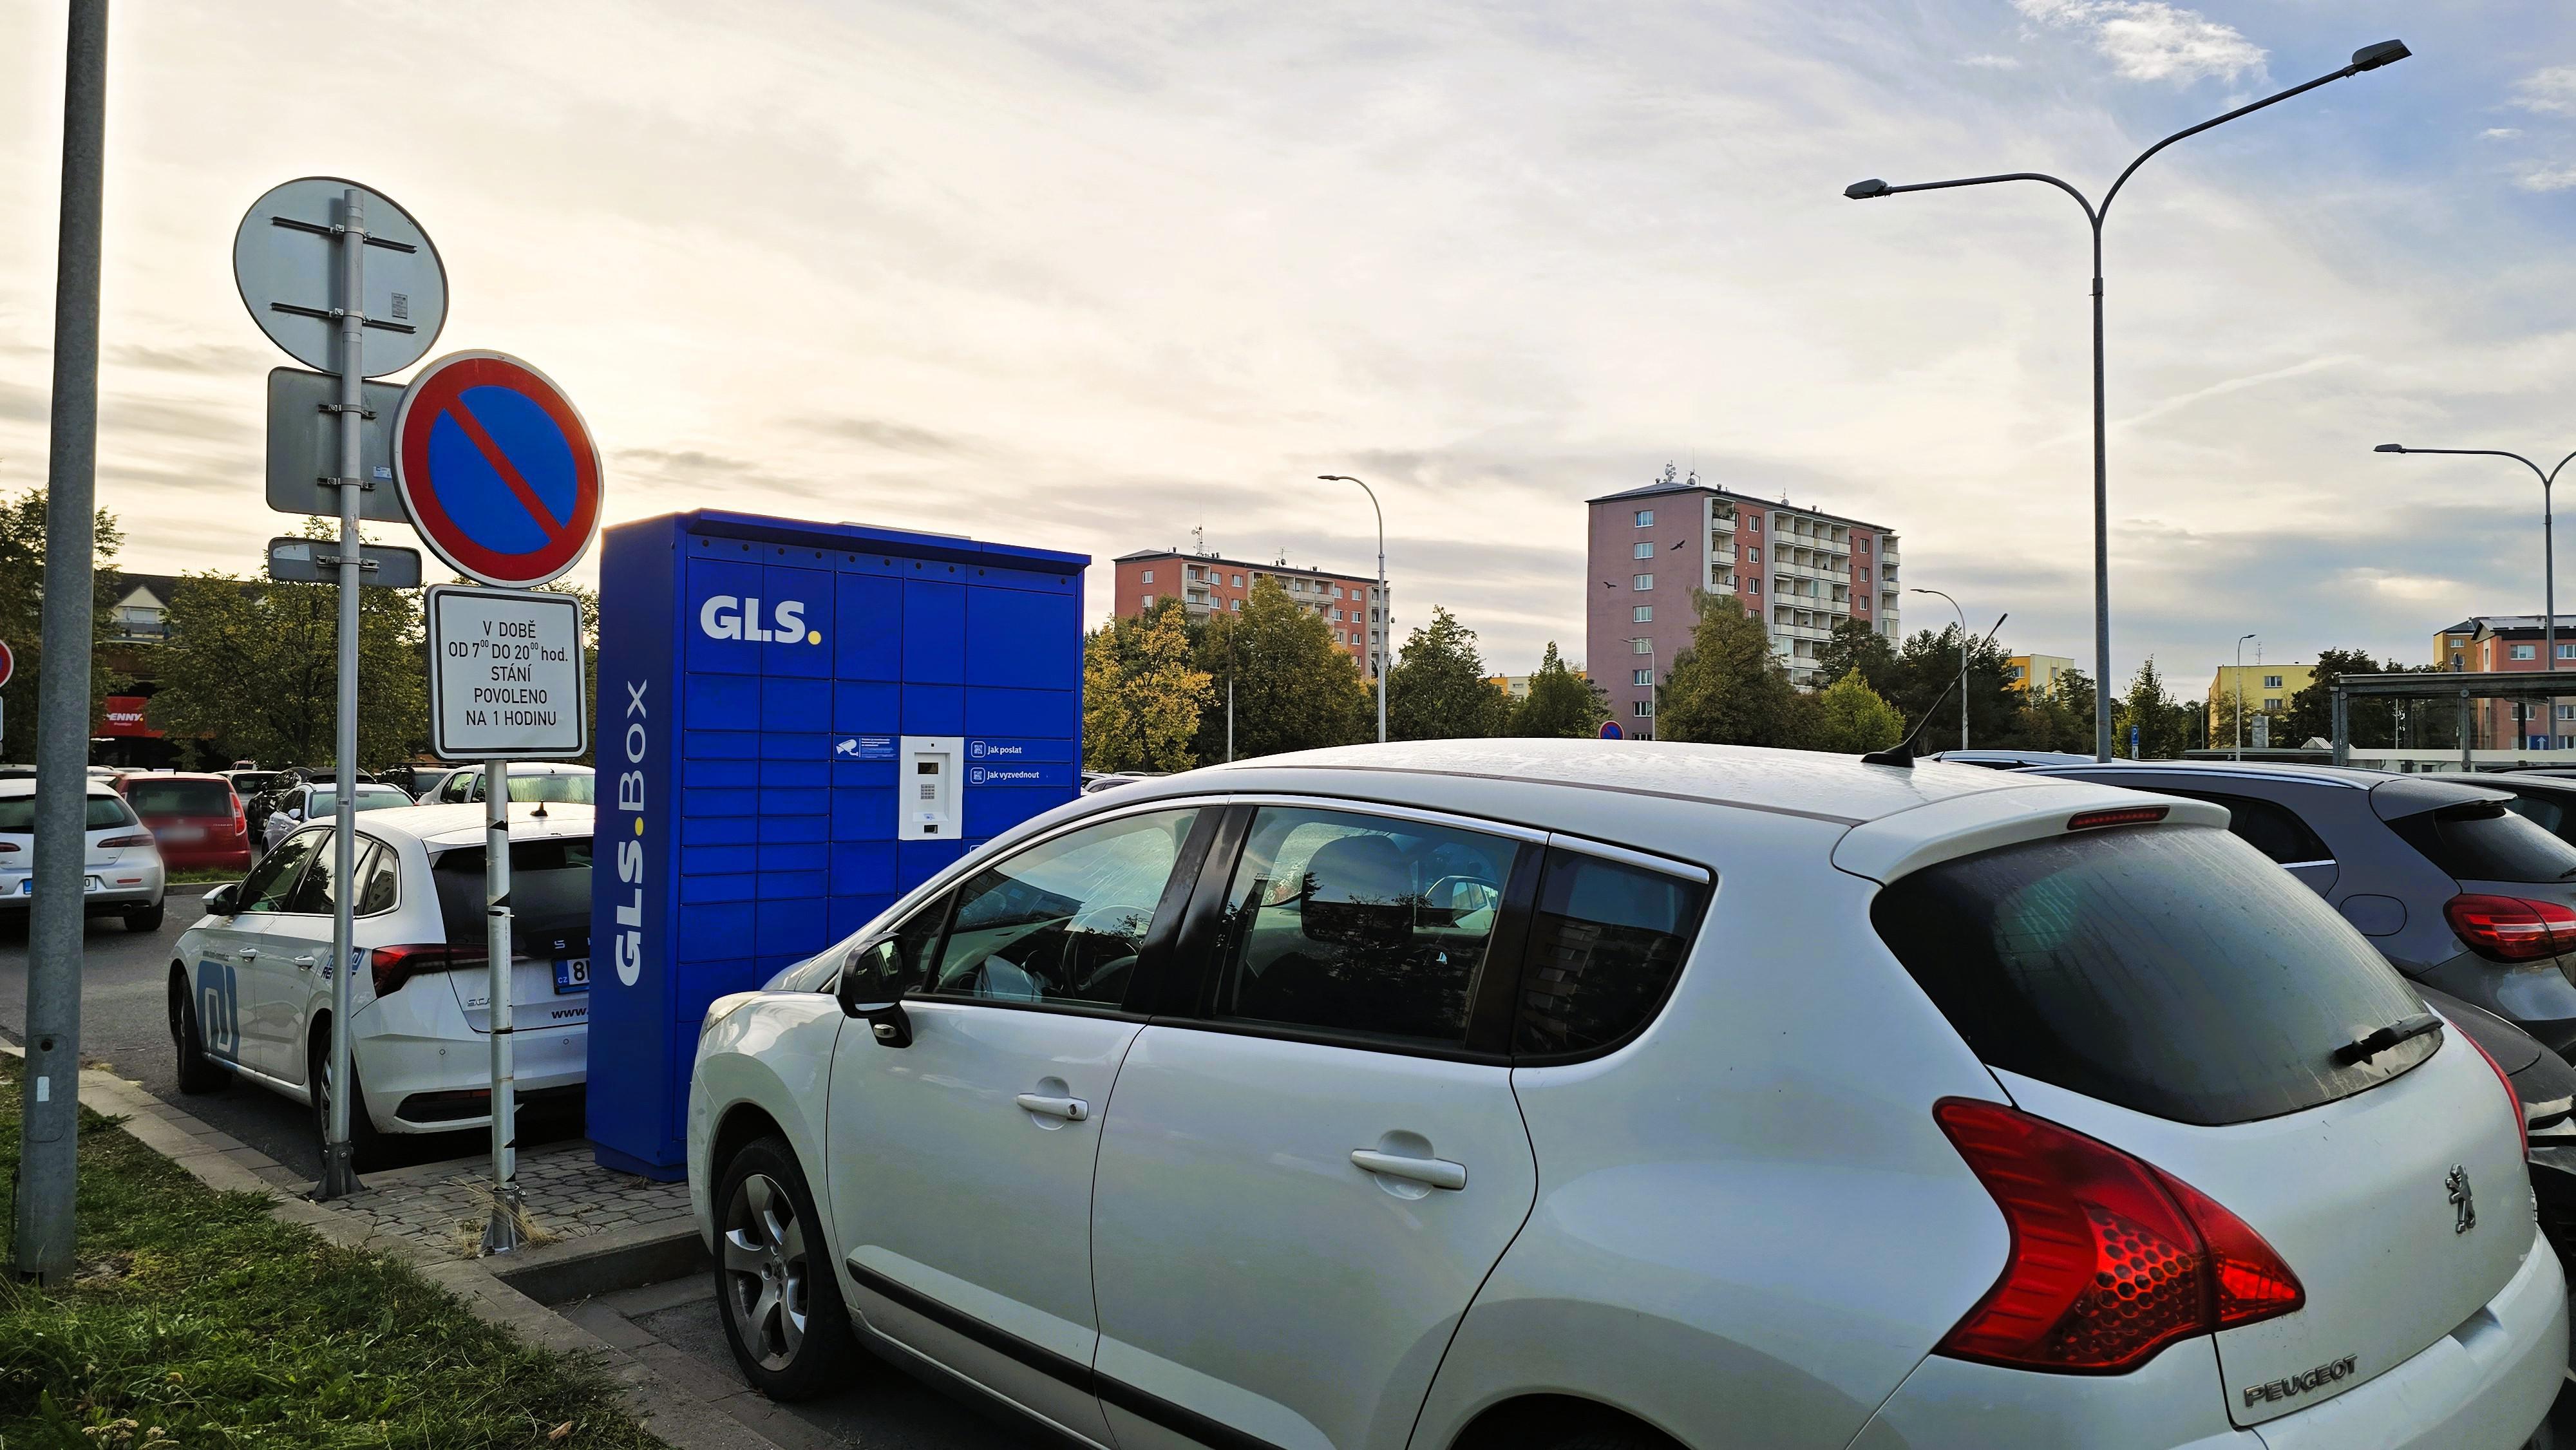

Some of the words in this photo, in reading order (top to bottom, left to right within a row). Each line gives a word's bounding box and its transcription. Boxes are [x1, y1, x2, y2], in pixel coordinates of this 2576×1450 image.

[483, 620, 492, 636] V
[499, 619, 536, 639] DOBĚ
[448, 641, 468, 657] OD
[491, 643, 511, 659] DO
[541, 646, 569, 662] hod.
[491, 663, 532, 683] STÁNÍ
[474, 687, 547, 704] POVOLENO
[106, 713, 144, 722] ENNY.
[466, 710, 488, 726] NA
[493, 710, 498, 726] 1
[504, 710, 556, 726] HODINU
[987, 746, 999, 755] Jak
[999, 746, 1022, 755] poslat
[987, 771, 999, 780] Jak
[999, 771, 1039, 780] vyzvednout
[2244, 1353, 2358, 1408] PEUGEOT
